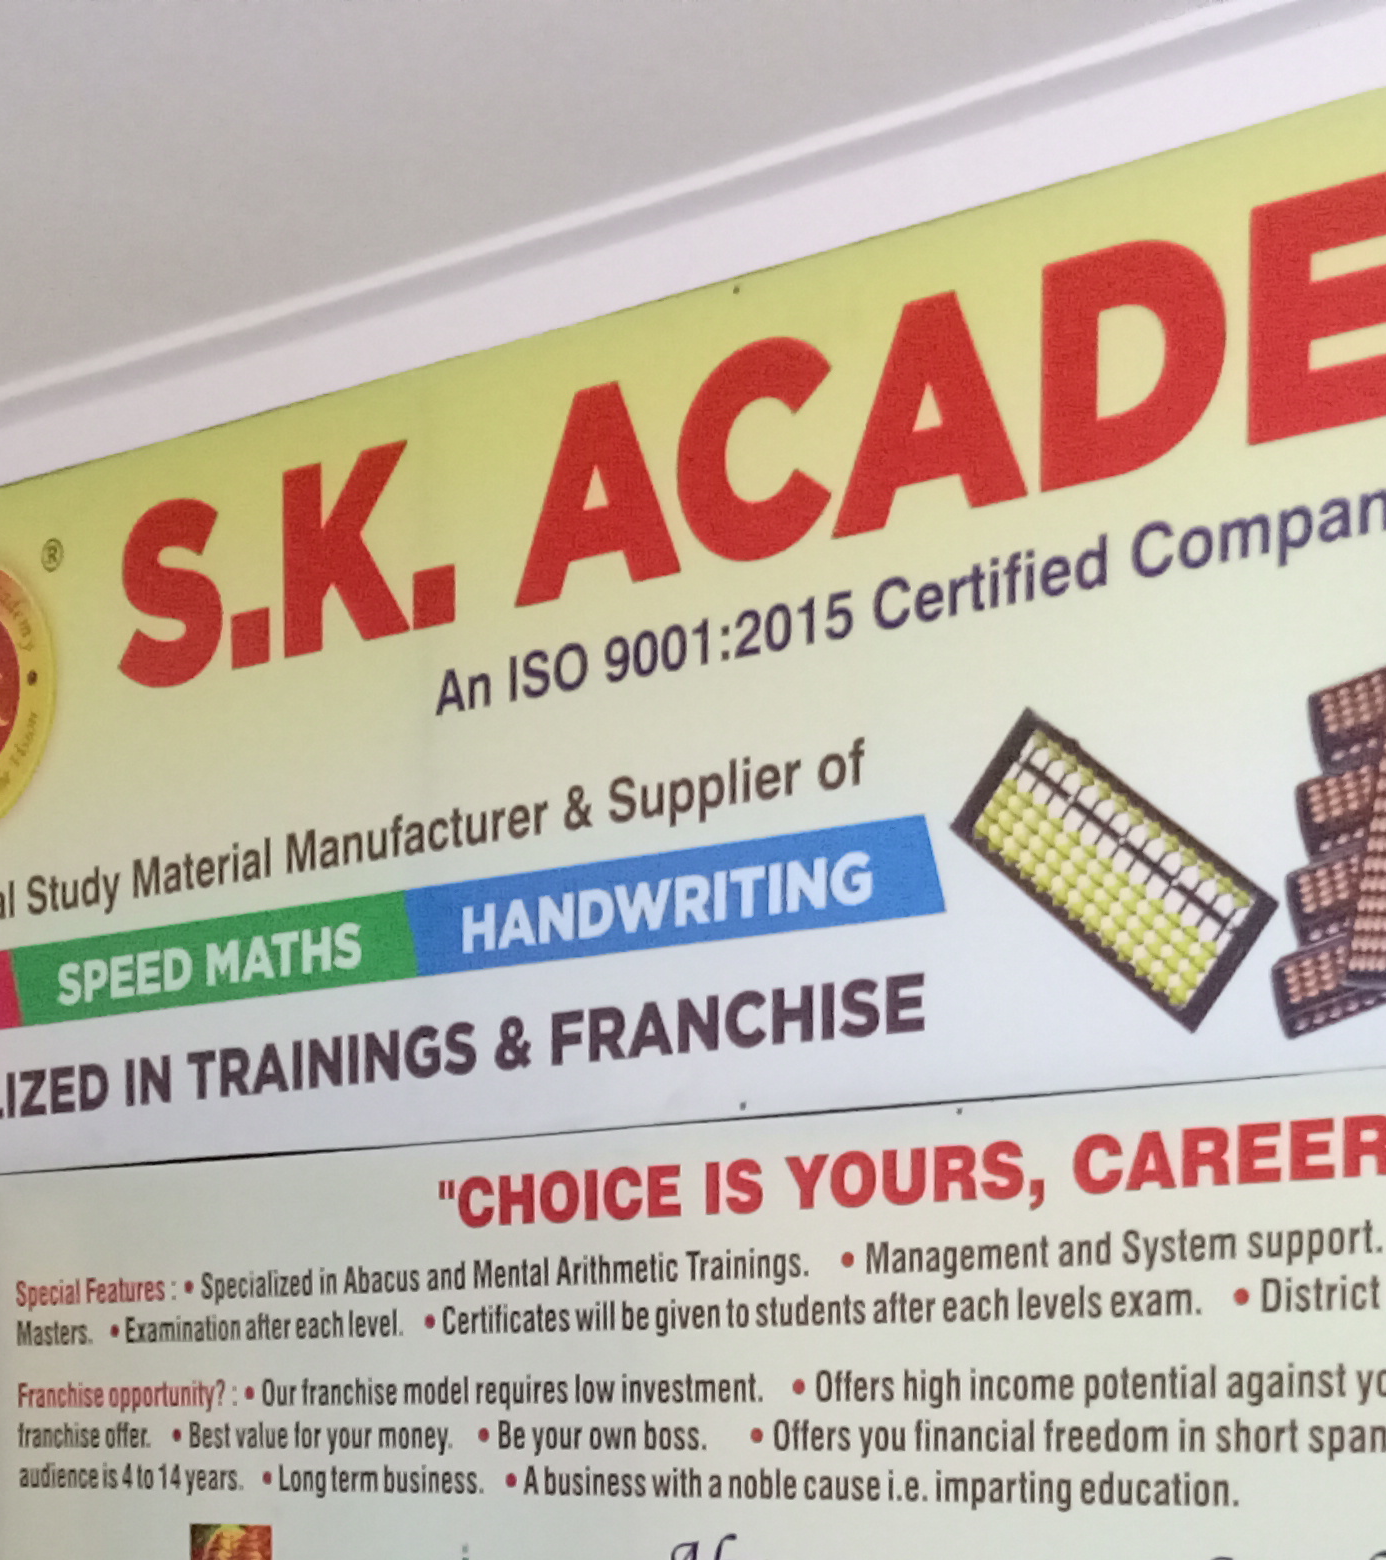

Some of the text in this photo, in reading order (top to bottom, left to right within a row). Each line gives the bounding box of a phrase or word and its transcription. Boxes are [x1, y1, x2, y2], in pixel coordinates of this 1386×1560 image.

[119, 440, 455, 687] S.K.
[436, 669, 491, 715] An
[510, 643, 588, 701] ISO
[605, 591, 853, 682] 9001:2015
[874, 534, 1107, 630] Certified
[27, 866, 120, 915] Study
[133, 838, 271, 898] Material
[287, 801, 548, 873] Manufacturer
[564, 785, 592, 830] &
[609, 757, 801, 827] Supplier
[818, 737, 864, 790] of
[59, 948, 192, 1005] SPEED
[207, 923, 361, 986] MATHS
[460, 850, 874, 954] HANDWRITING
[126, 1055, 171, 1106] IN
[187, 1022, 476, 1099] TRAININGS
[495, 1016, 531, 1070] &
[552, 973, 924, 1065] FRANCHISE
[439, 1165, 681, 1228] "CHOICE
[706, 1159, 763, 1215] IS
[785, 1141, 1044, 1210] YOURS,
[16, 1277, 165, 1311] Special Features
[202, 1248, 808, 1305] Specialized in Abacus and Mental Arithmetic Trainings.
[1262, 1275, 1379, 1312] District
[18, 1379, 225, 1413] Franchise opportunity?
[499, 1420, 706, 1456] Be your own boss.
[20, 1462, 243, 1496] audience is 4 to 14 years.
